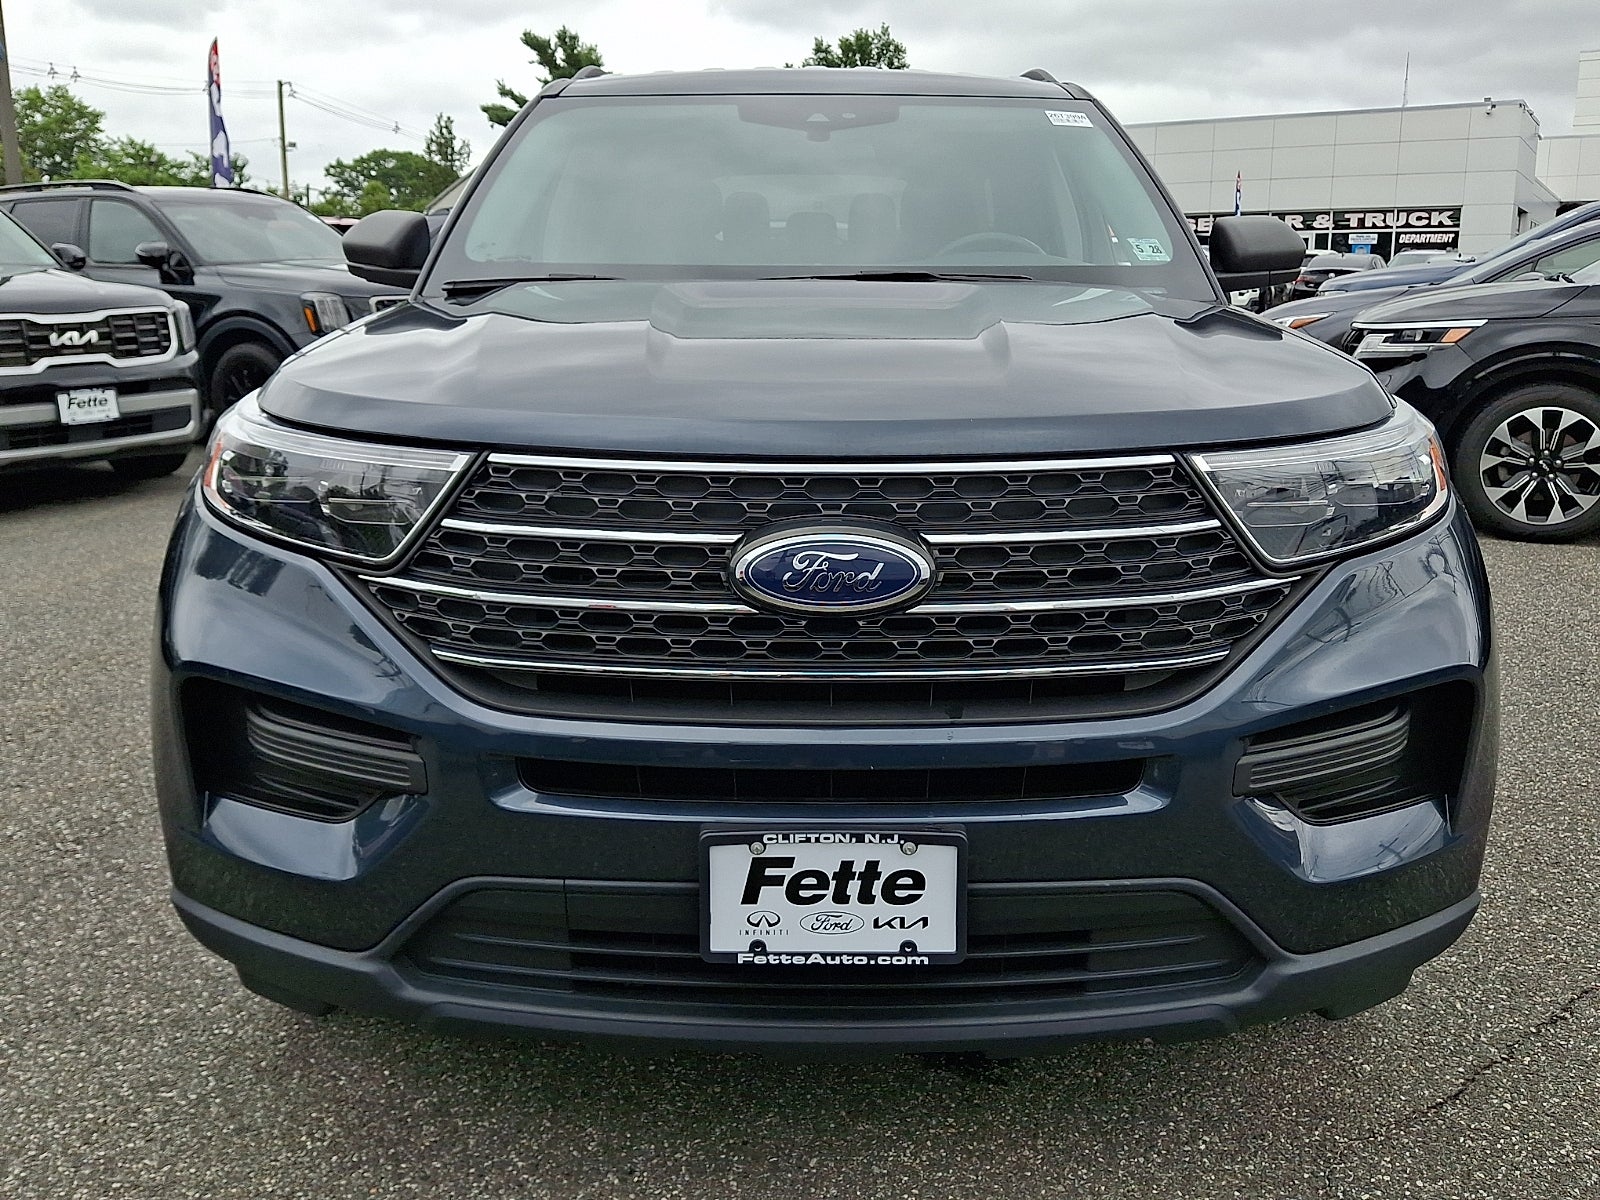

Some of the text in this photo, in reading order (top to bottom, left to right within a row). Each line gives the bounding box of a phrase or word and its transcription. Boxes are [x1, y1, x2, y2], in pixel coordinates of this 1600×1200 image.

[1312, 214, 1335, 228] &
[1344, 210, 1455, 228] TRUCK
[1399, 233, 1456, 244] DEPARTMENT
[50, 330, 99, 347] KIA
[67, 397, 108, 409] Fette
[782, 550, 885, 593] Ford
[763, 833, 905, 844] CLIFTON, N.J.
[740, 856, 927, 905] Fette
[810, 914, 854, 931] Ford
[873, 916, 929, 929] KIA
[737, 952, 929, 965] FetteAuto.com
